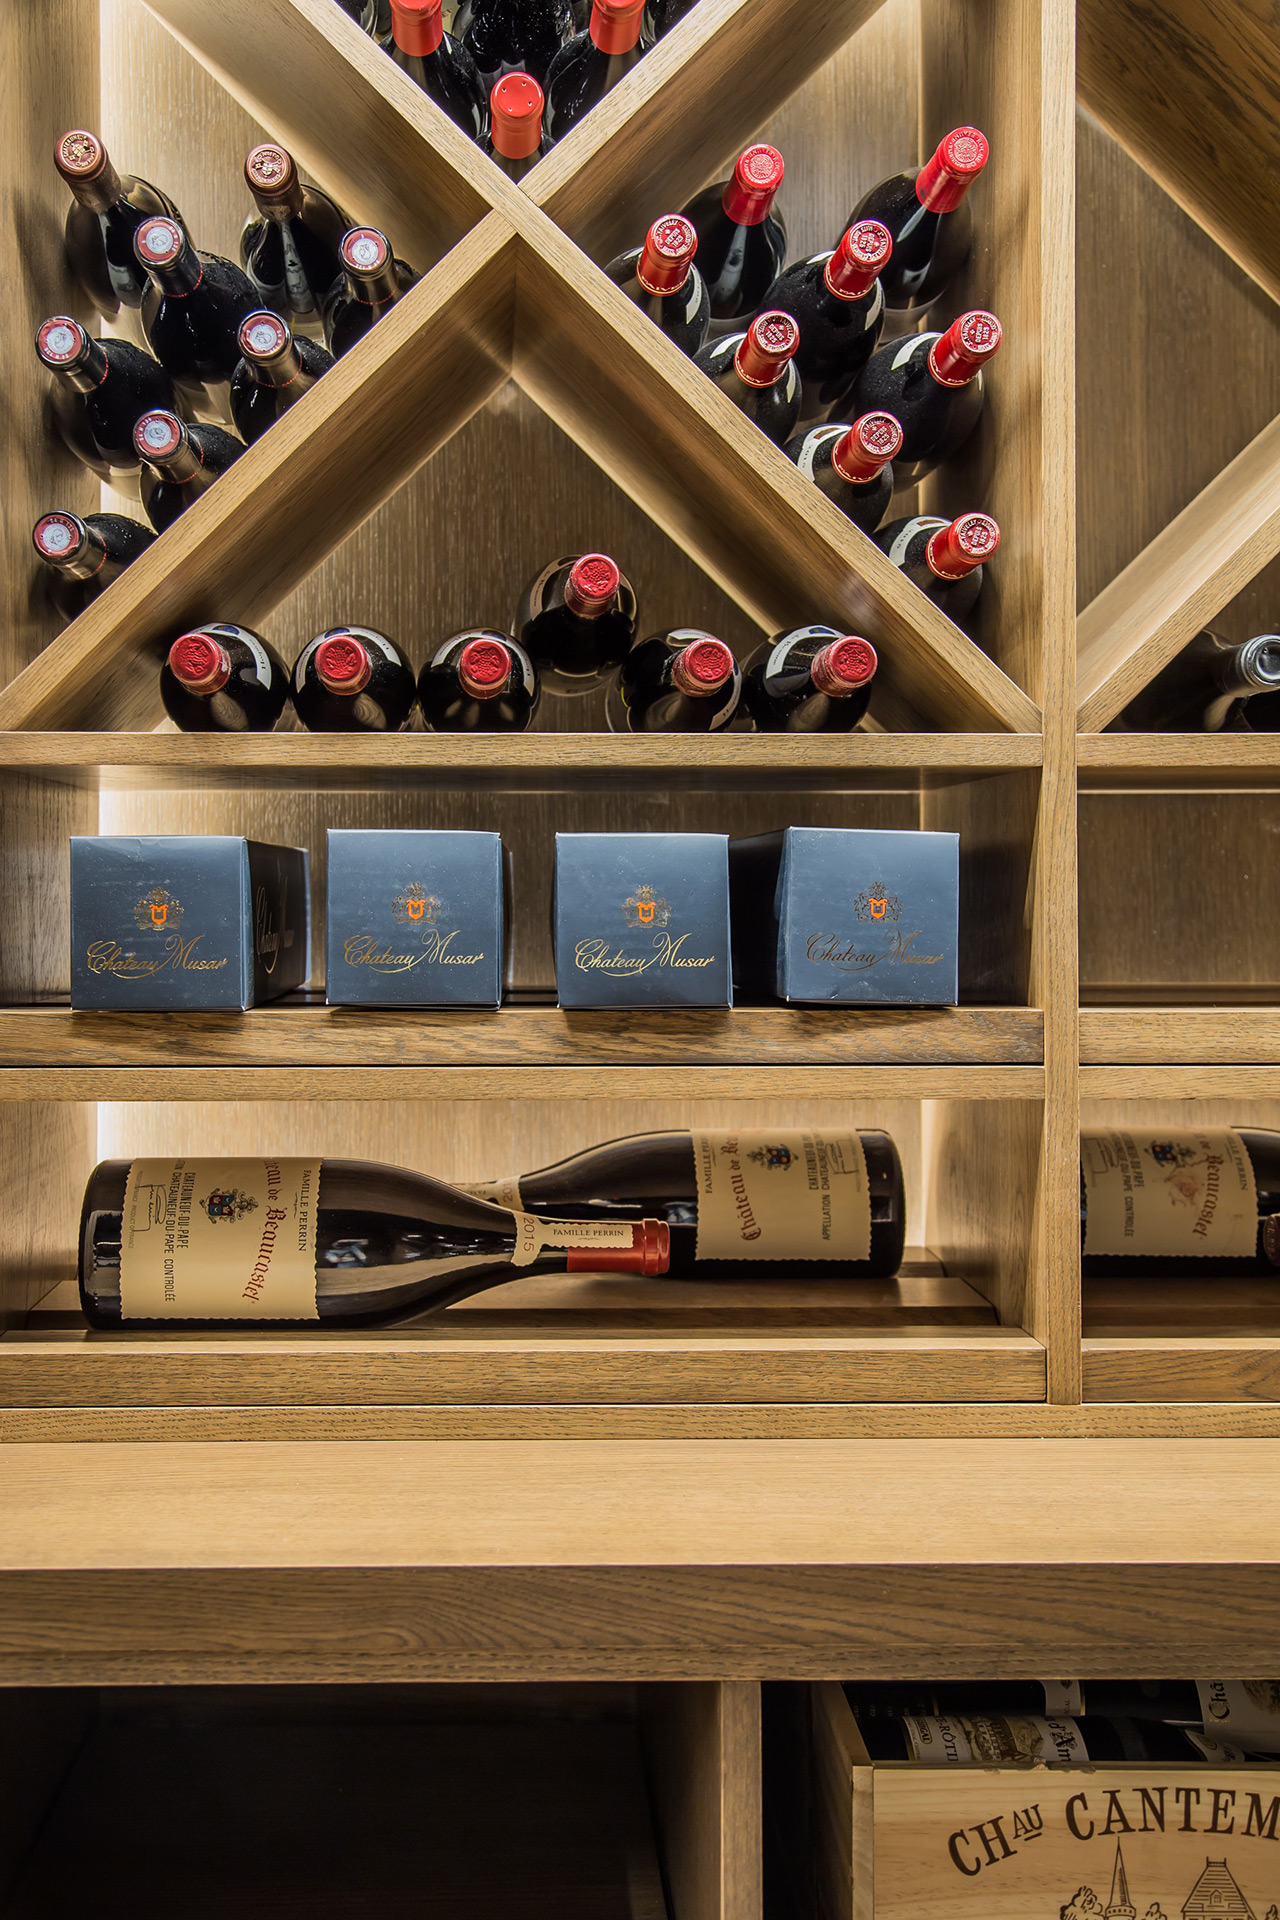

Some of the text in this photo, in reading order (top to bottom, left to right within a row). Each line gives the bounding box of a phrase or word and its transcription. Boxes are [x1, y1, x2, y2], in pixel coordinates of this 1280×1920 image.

[663, 227, 681, 245] DEPUIS
[671, 234, 684, 247] 1825
[859, 234, 867, 248] 1825
[865, 232, 874, 252] DEPUIS
[764, 330, 777, 343] 1825
[767, 322, 784, 341] DEPUIS
[975, 322, 983, 343] DEPUIS
[869, 425, 887, 442] DEPUIS
[876, 432, 890, 446] 1825
[970, 525, 983, 546] DEPUIS
[978, 530, 988, 545] 1825
[86, 934, 228, 980] Chateau Musar
[343, 929, 486, 974] Chateau Musar
[574, 931, 715, 978] Chateau Musar
[806, 927, 945, 971] Chateau Musar
[703, 1155, 713, 1194] FAMILLE
[727, 1159, 741, 1171] de
[1234, 1157, 1248, 1191] PERRIN
[268, 1188, 283, 1201] de
[502, 1183, 513, 1203] 201
[1192, 1153, 1226, 1237] Beaucastel
[298, 1169, 312, 1252] FAMILLE PERRIN
[729, 1174, 762, 1241] Château
[821, 1194, 831, 1241] APPELLATION
[1124, 1196, 1135, 1237] CONTROLÉE
[523, 1217, 535, 1253] 2015
[552, 1228, 624, 1237] FAMILLE PERRIN
[242, 1206, 288, 1301] Beaucastel
[163, 1258, 176, 1302] CONTROLÉE
